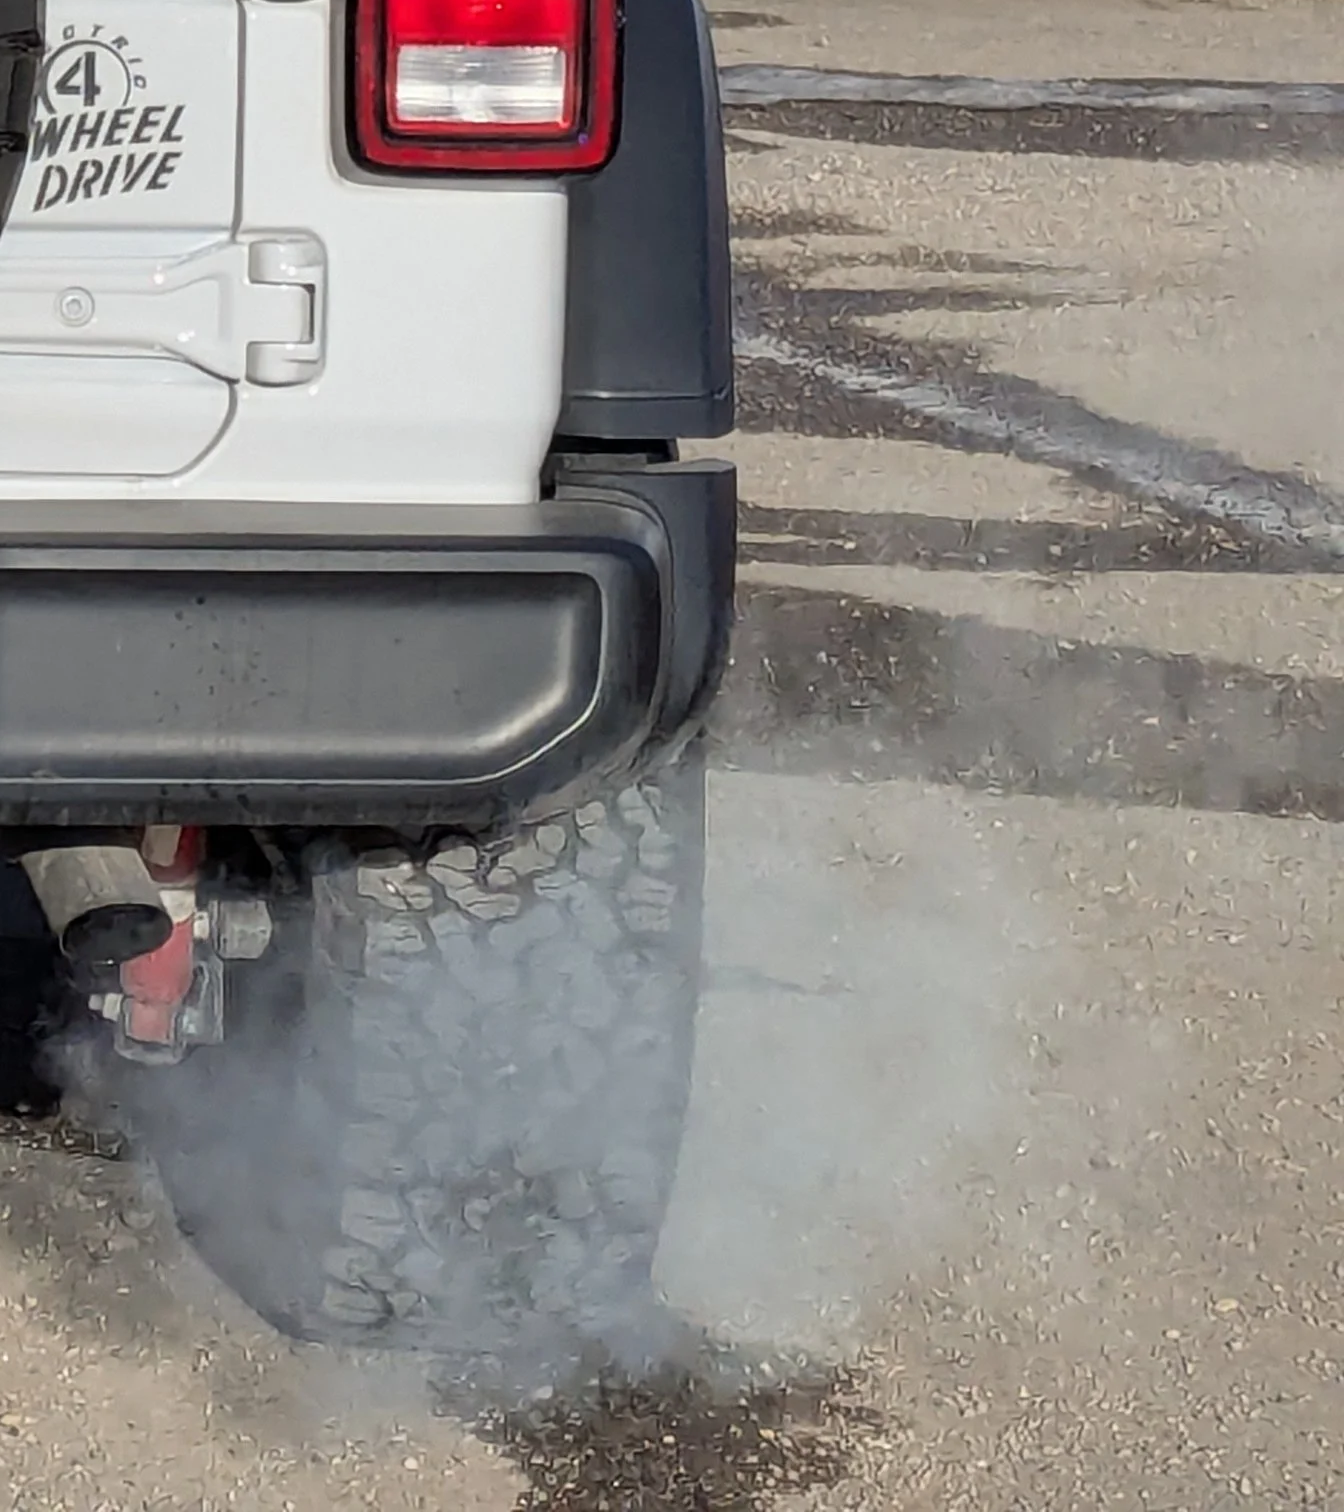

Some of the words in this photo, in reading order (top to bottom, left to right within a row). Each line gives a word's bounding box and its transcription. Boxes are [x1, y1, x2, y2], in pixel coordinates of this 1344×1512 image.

[54, 51, 102, 108] 4
[30, 104, 187, 163] WHEEL
[32, 151, 183, 213] DRIVE
